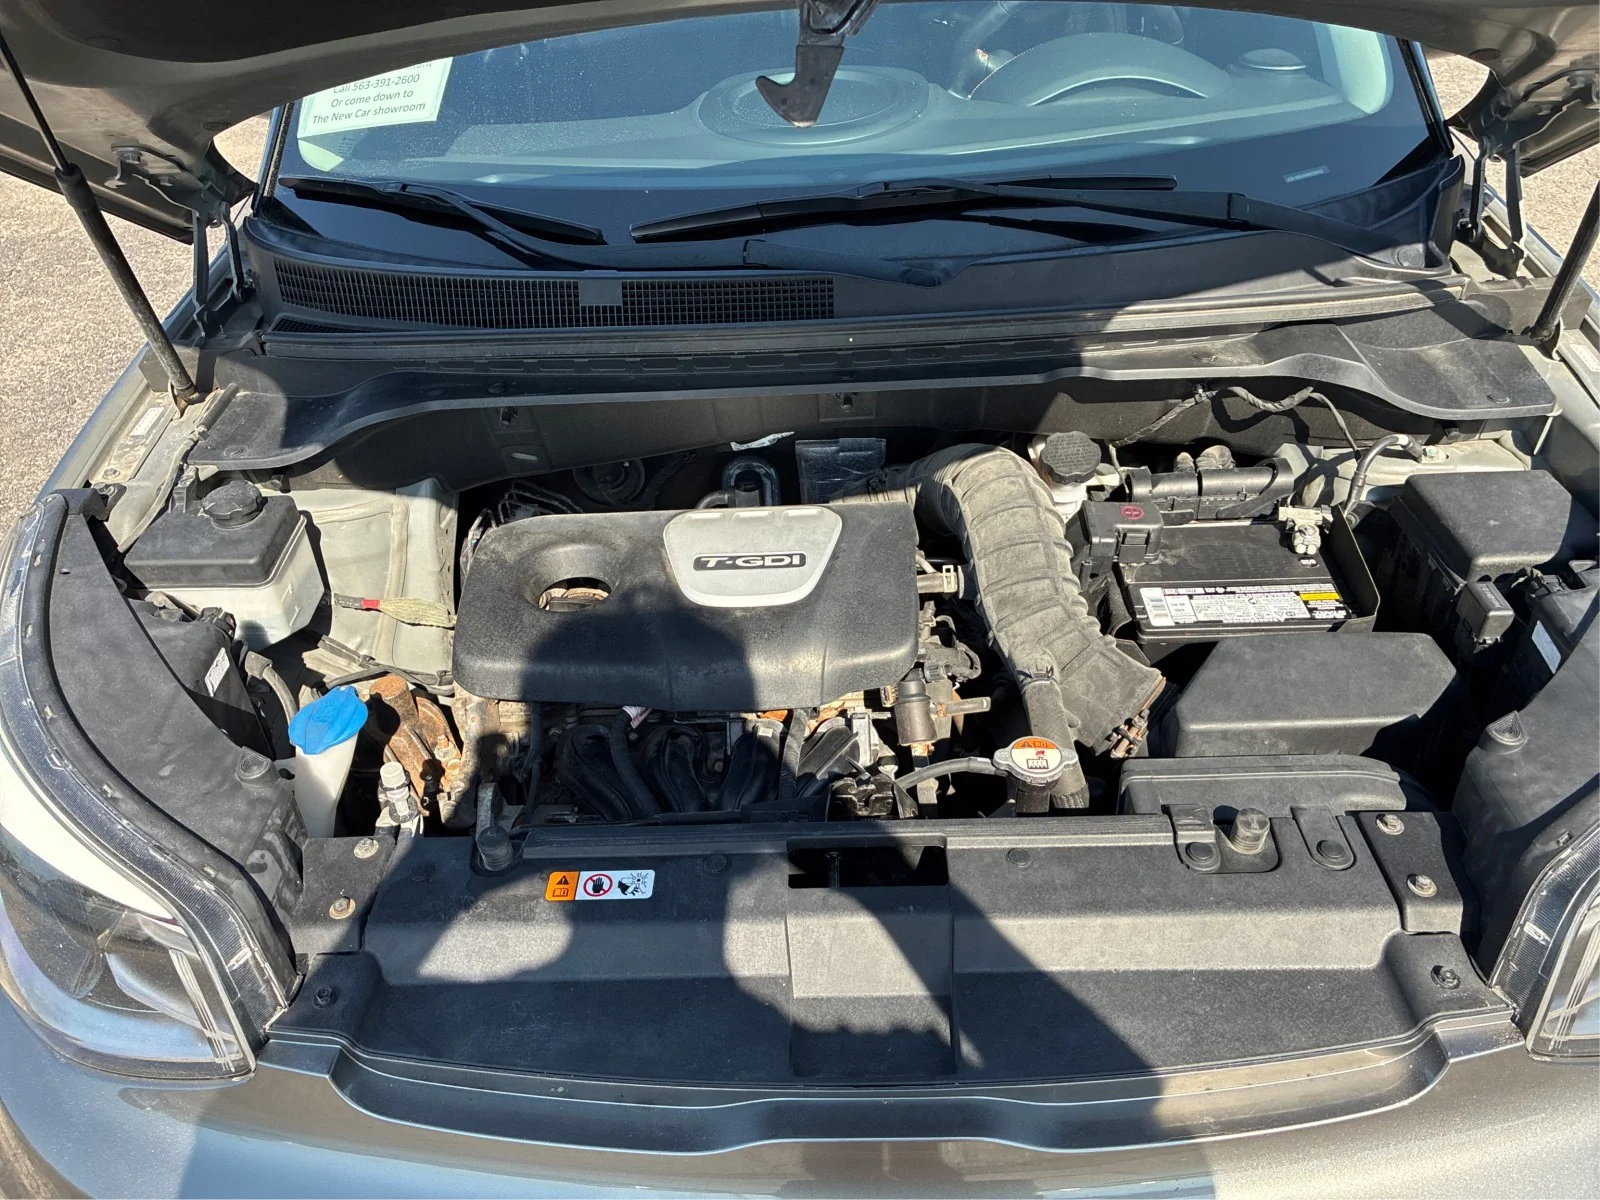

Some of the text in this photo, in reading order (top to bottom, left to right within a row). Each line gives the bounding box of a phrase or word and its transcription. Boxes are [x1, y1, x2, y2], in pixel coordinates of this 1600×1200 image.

[353, 73, 420, 92] 563-391-2600
[331, 89, 413, 108] Or come down to
[312, 102, 426, 125] The New Car showroom
[700, 554, 800, 568] T-GDI
